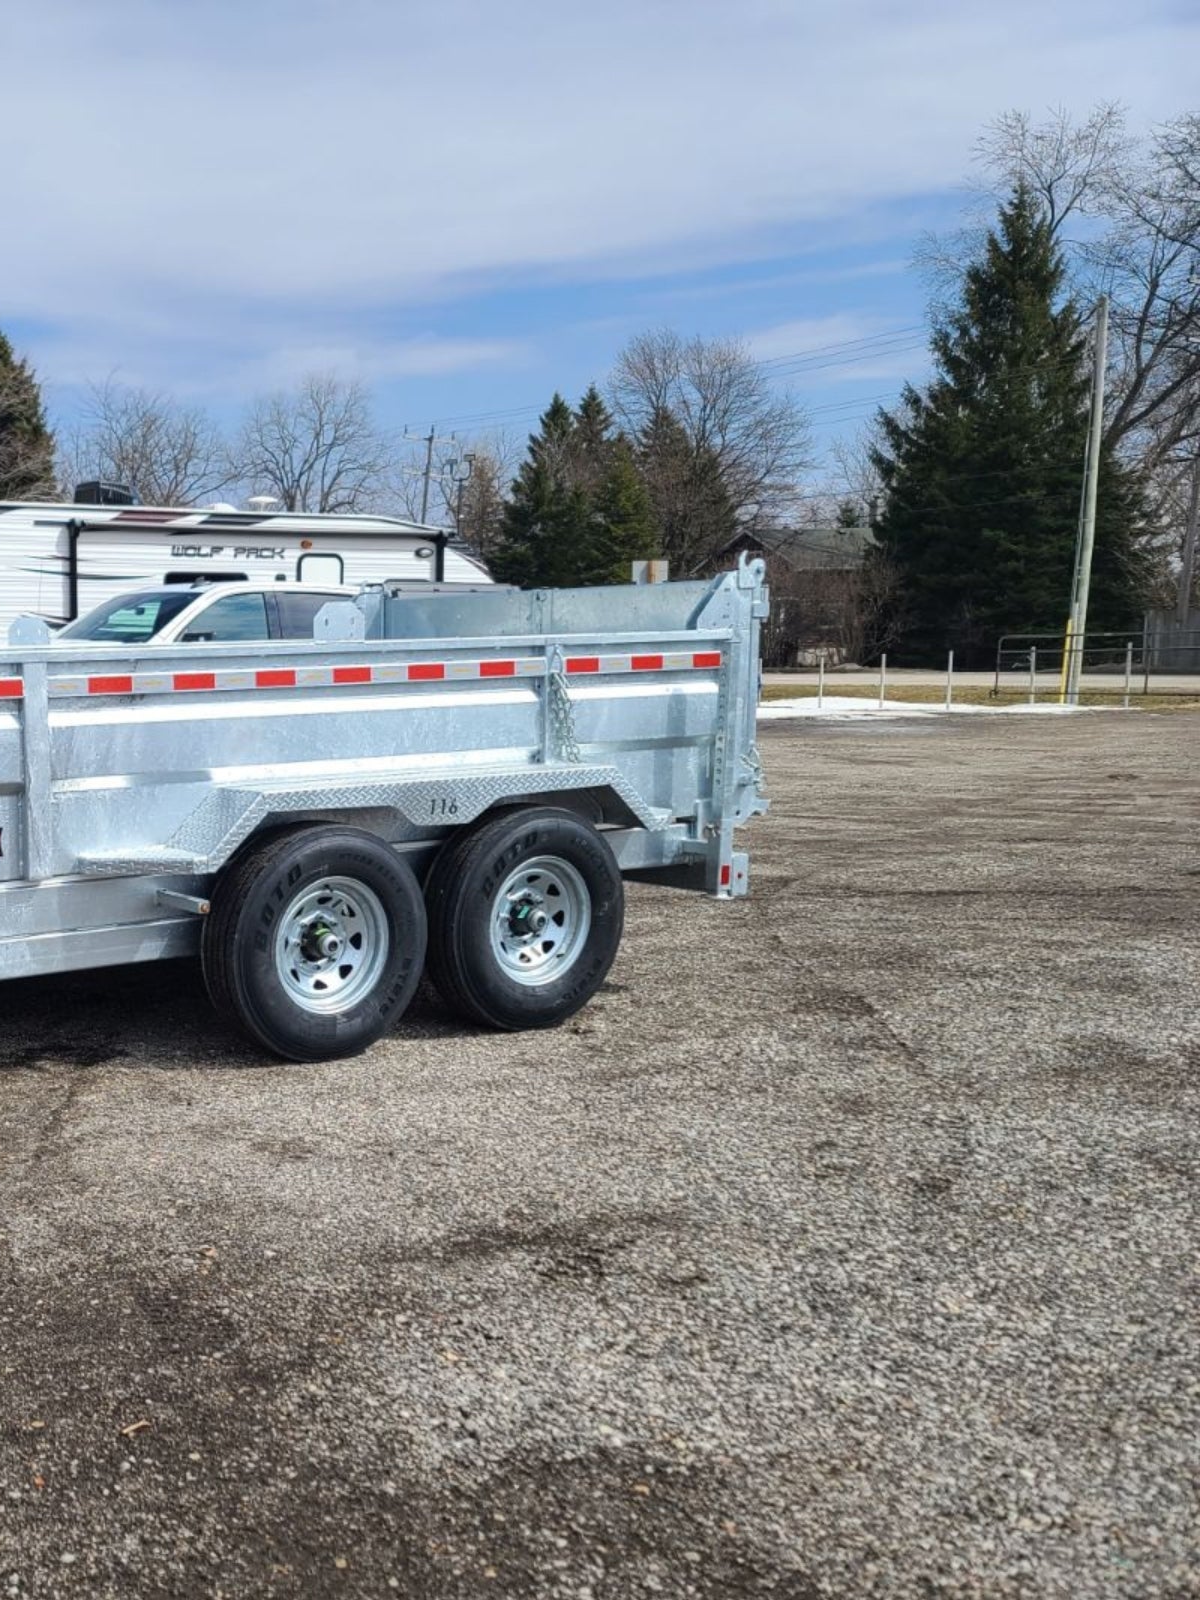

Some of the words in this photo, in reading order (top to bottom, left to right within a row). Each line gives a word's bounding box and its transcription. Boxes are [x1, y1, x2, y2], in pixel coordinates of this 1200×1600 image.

[170, 545, 224, 558] WOLF
[233, 546, 286, 559] PACK
[430, 797, 458, 815] 116
